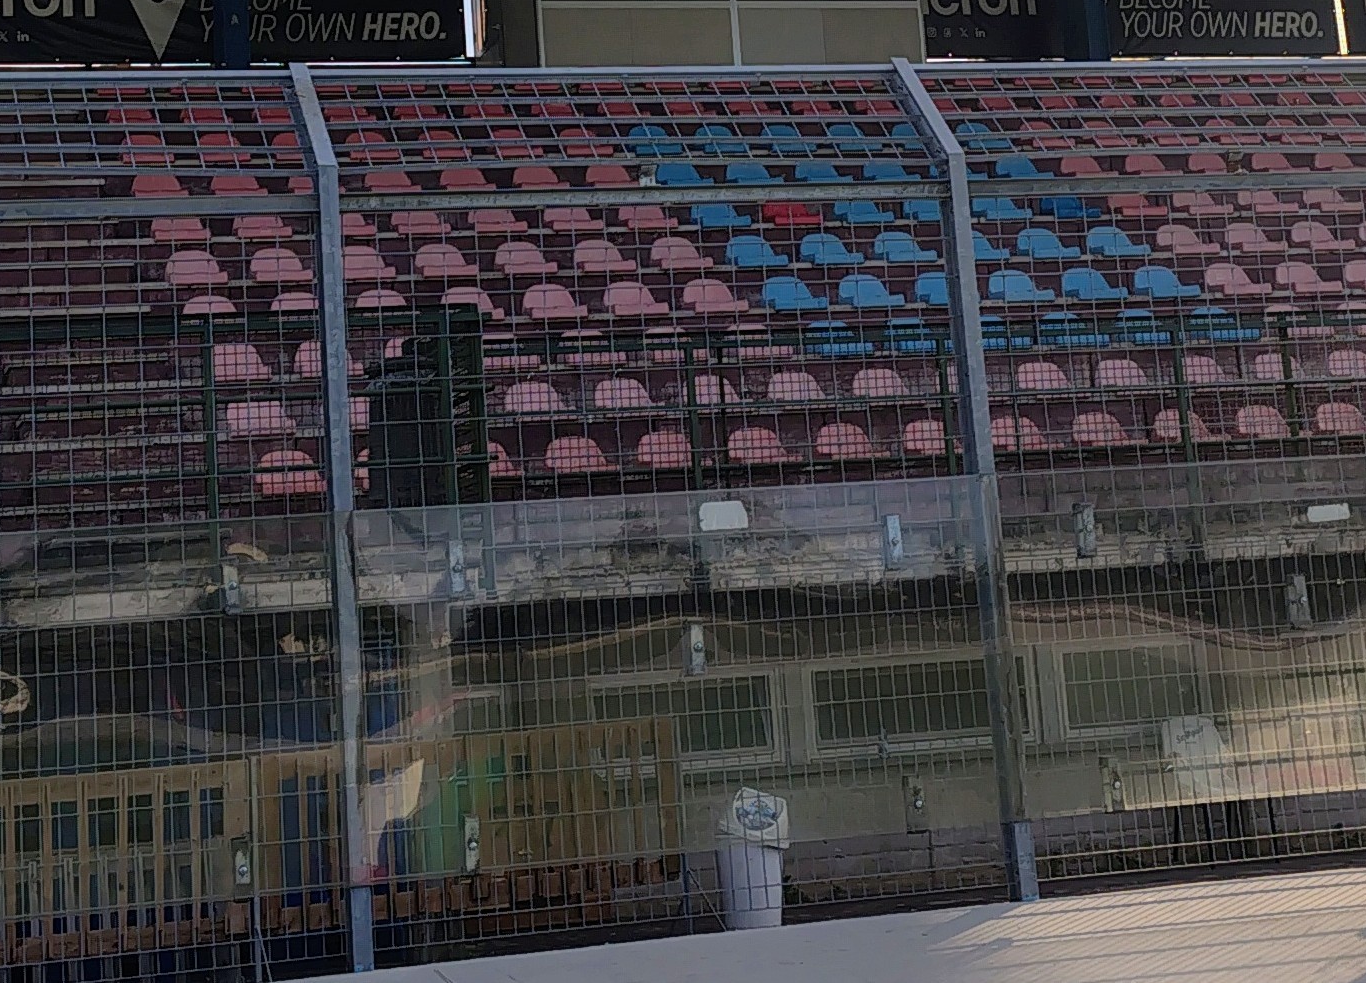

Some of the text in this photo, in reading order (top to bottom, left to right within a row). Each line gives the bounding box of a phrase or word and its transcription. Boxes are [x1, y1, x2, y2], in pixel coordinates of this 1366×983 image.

[285, 13, 356, 43] OWN
[362, 11, 447, 42] HERO.
[1120, 10, 1324, 39] YOUR OWN HERO.
